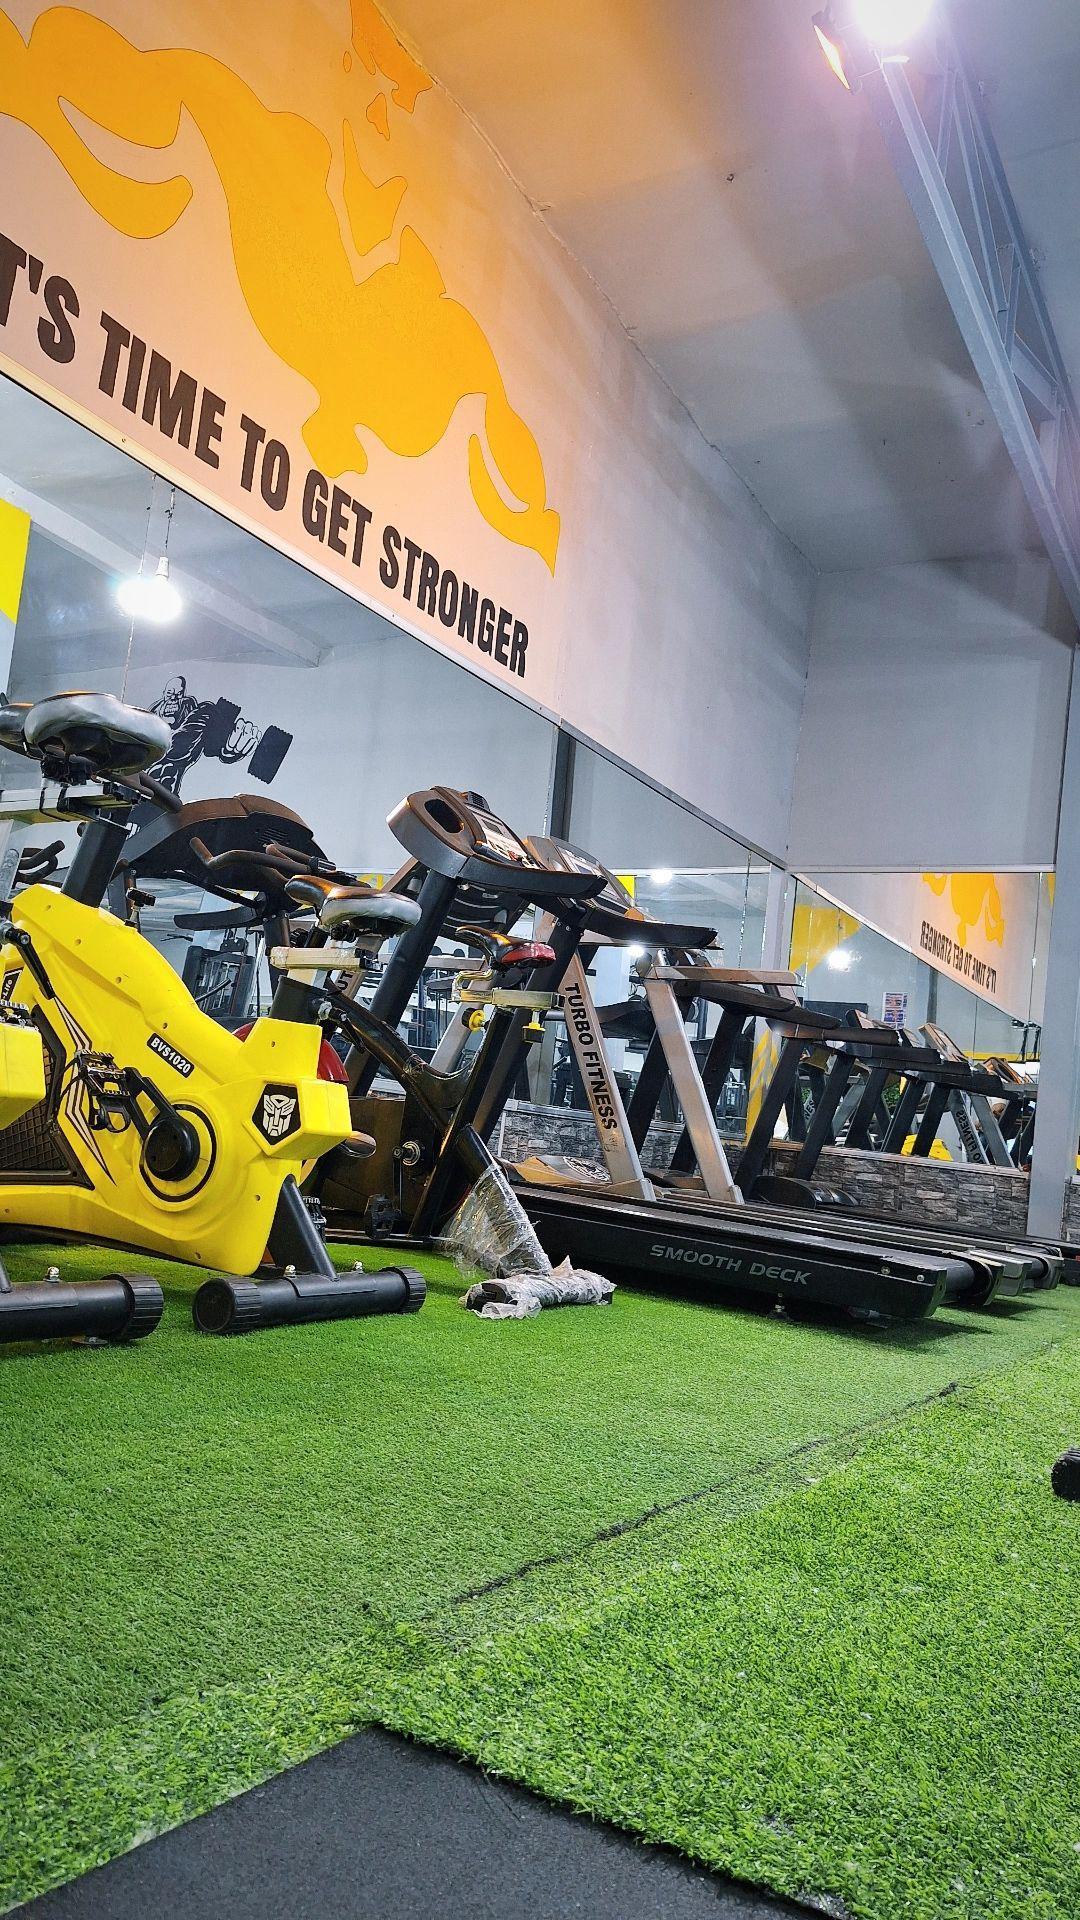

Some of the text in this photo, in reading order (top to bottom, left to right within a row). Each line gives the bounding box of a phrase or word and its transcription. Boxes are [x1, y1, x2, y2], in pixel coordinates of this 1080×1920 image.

[98, 310, 227, 470] TIME
[240, 413, 291, 511] TO
[301, 468, 373, 568] GET
[379, 525, 529, 679] STRONGER
[150, 1037, 192, 1074] BVS1020
[564, 982, 594, 1046] TURBO
[582, 1051, 618, 1130] FITNESS
[650, 1244, 812, 1285] SMOOTH DECK
